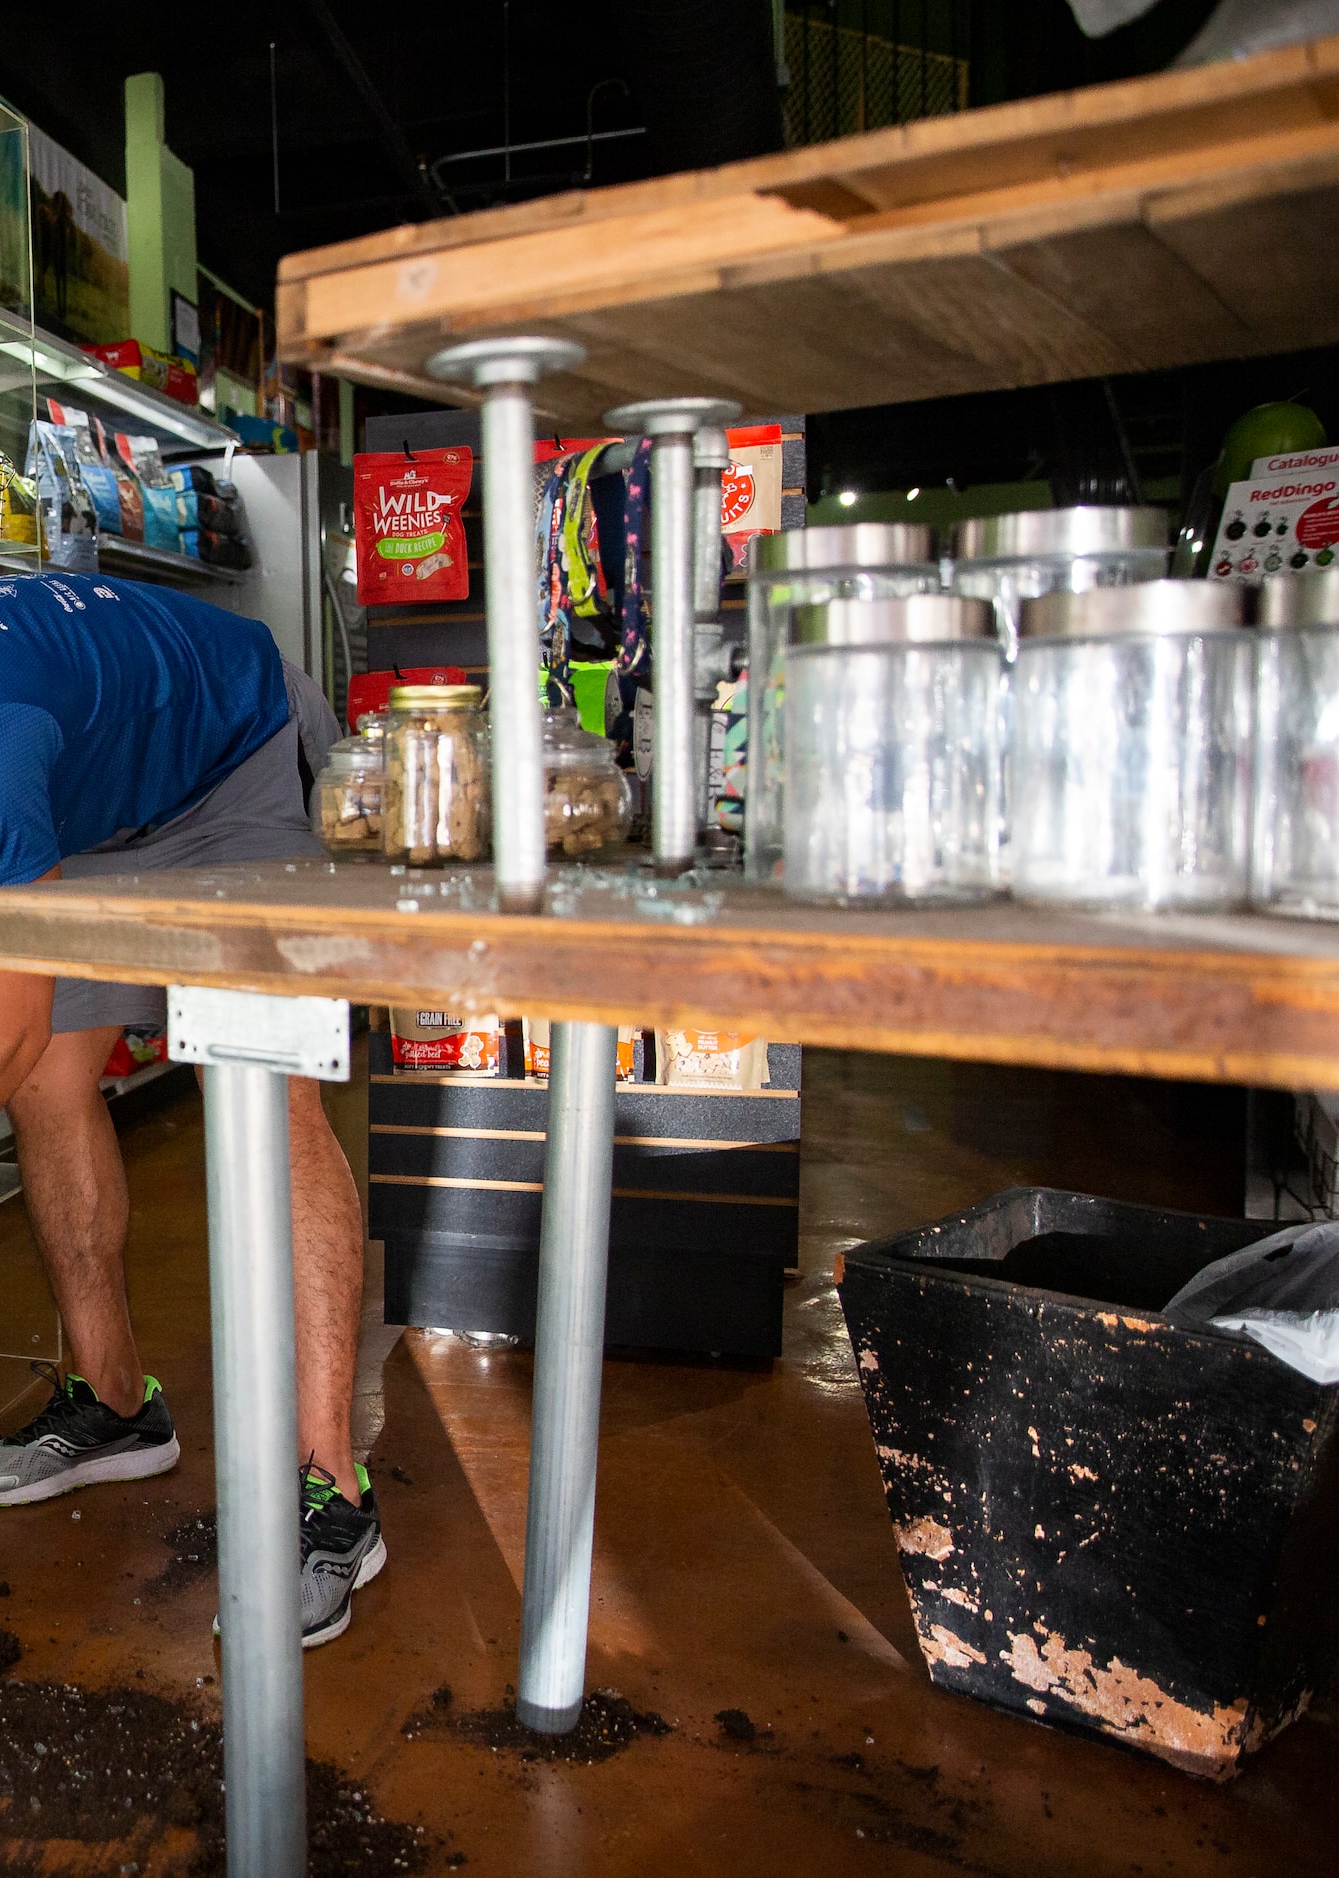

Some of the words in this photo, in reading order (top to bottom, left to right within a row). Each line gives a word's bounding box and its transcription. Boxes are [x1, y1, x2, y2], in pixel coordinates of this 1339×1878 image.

[1268, 453, 1339, 471] Catalogu
[1250, 481, 1336, 502] RedDingo
[379, 486, 442, 518] WILD
[373, 510, 441, 535] WEENIES
[406, 528, 429, 537] TREATS
[395, 542, 412, 554] DUCK
[413, 537, 437, 553] RECIPE
[419, 1011, 443, 1026] GRAIN
